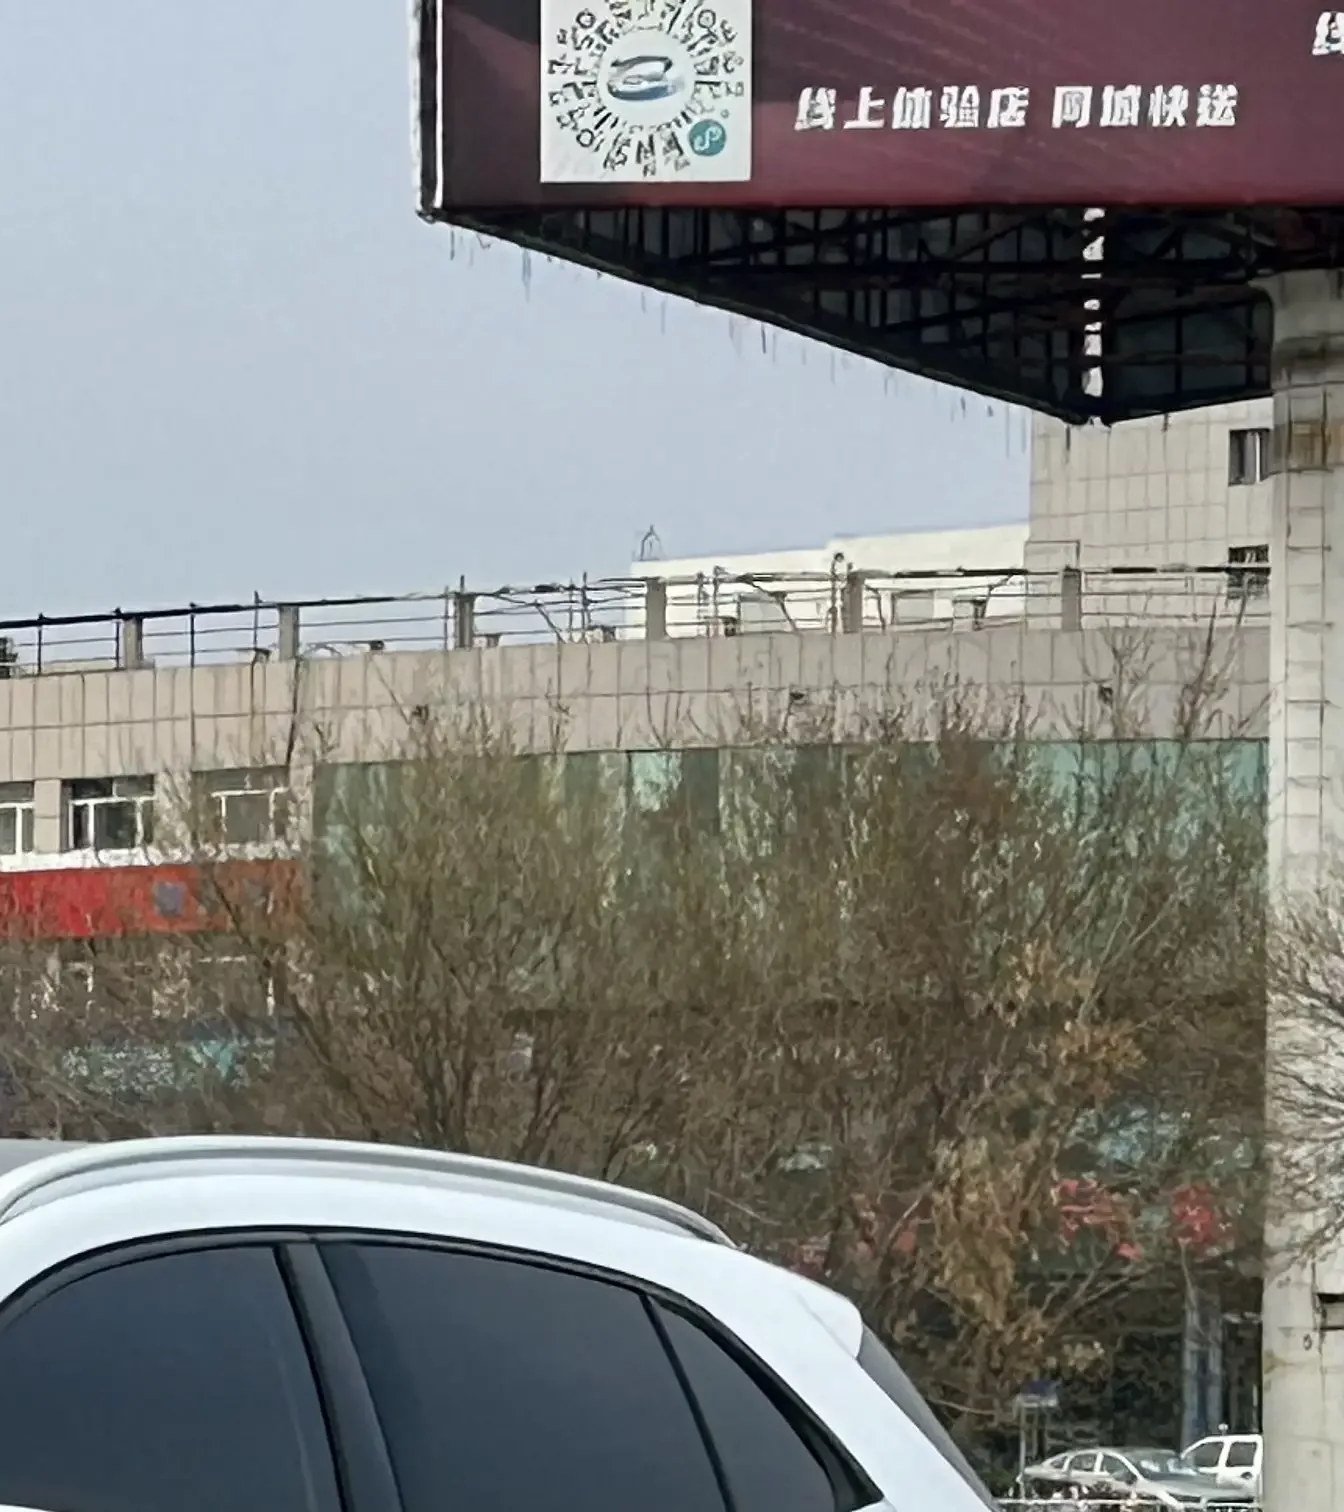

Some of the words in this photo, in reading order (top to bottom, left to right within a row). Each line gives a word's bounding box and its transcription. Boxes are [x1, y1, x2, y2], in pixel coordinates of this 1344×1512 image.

[795, 85, 1029, 130] 线上体验店
[1052, 84, 1238, 128] 同城快送
